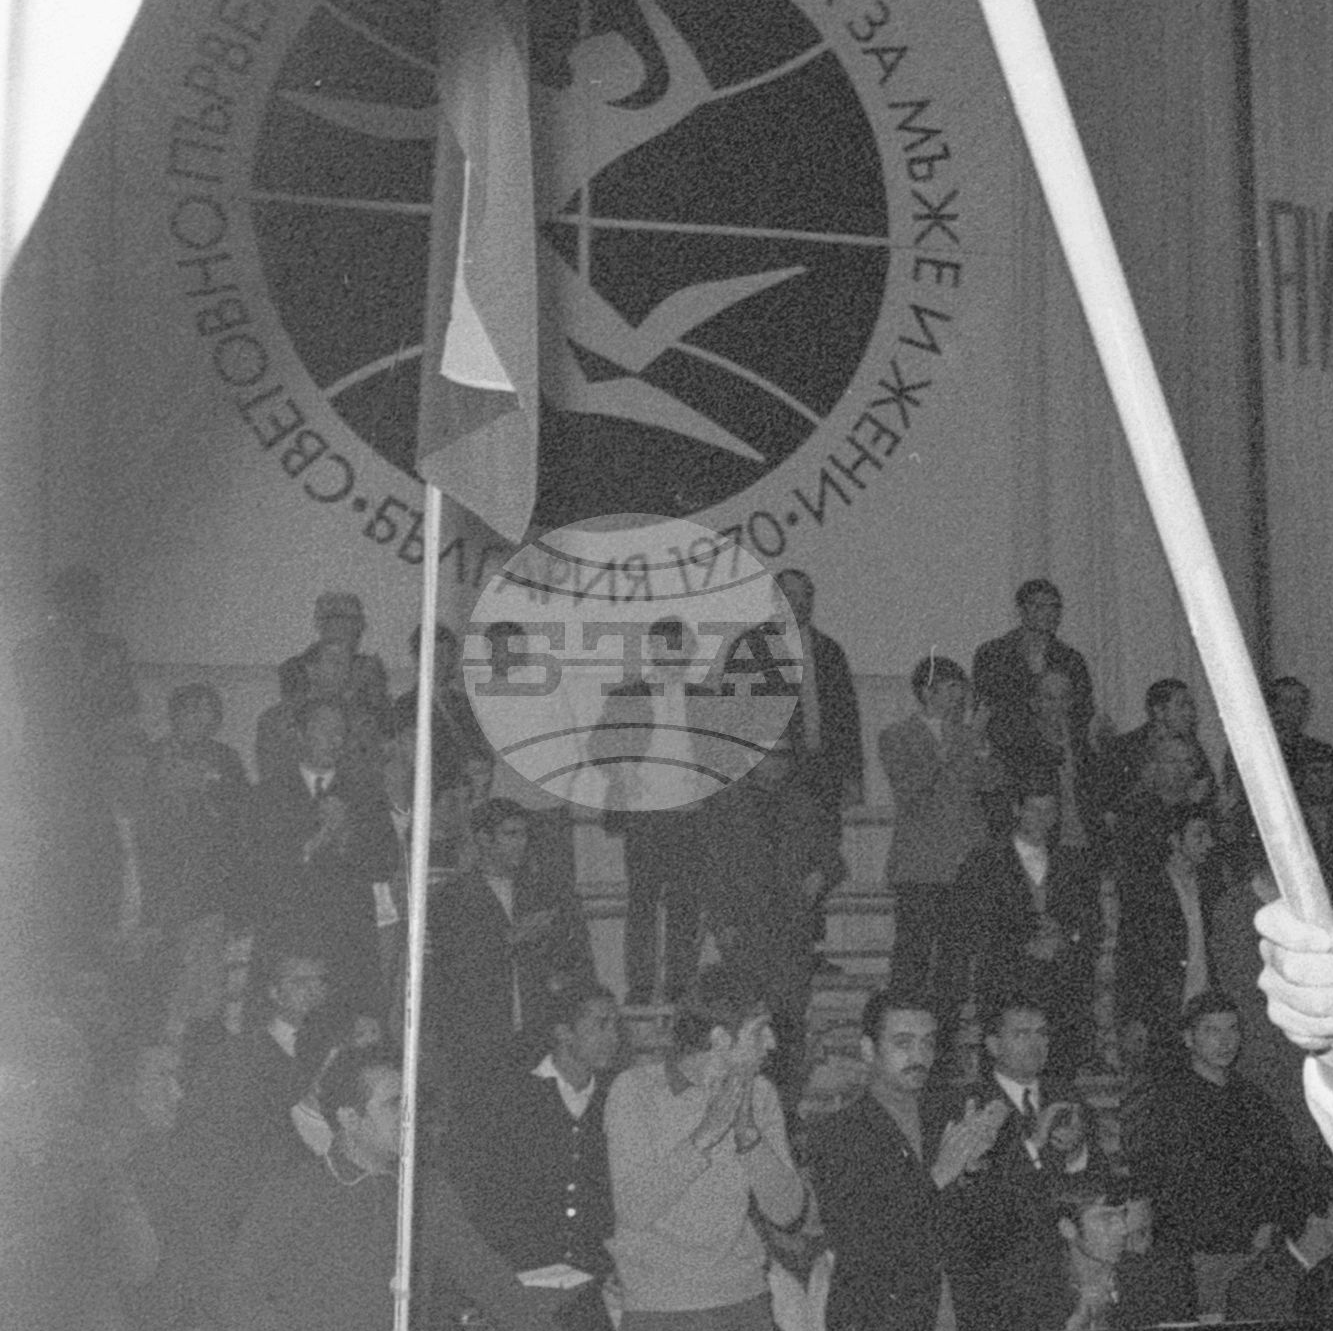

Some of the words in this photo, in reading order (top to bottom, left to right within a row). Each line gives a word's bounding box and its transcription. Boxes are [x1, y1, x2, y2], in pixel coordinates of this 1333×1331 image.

[886, 97, 963, 289] МЪЖЕ
[168, 195, 356, 504] СВЕТОВНО
[899, 302, 954, 357] И
[792, 358, 934, 527] ЖЕНИ
[669, 509, 788, 597] 1970
